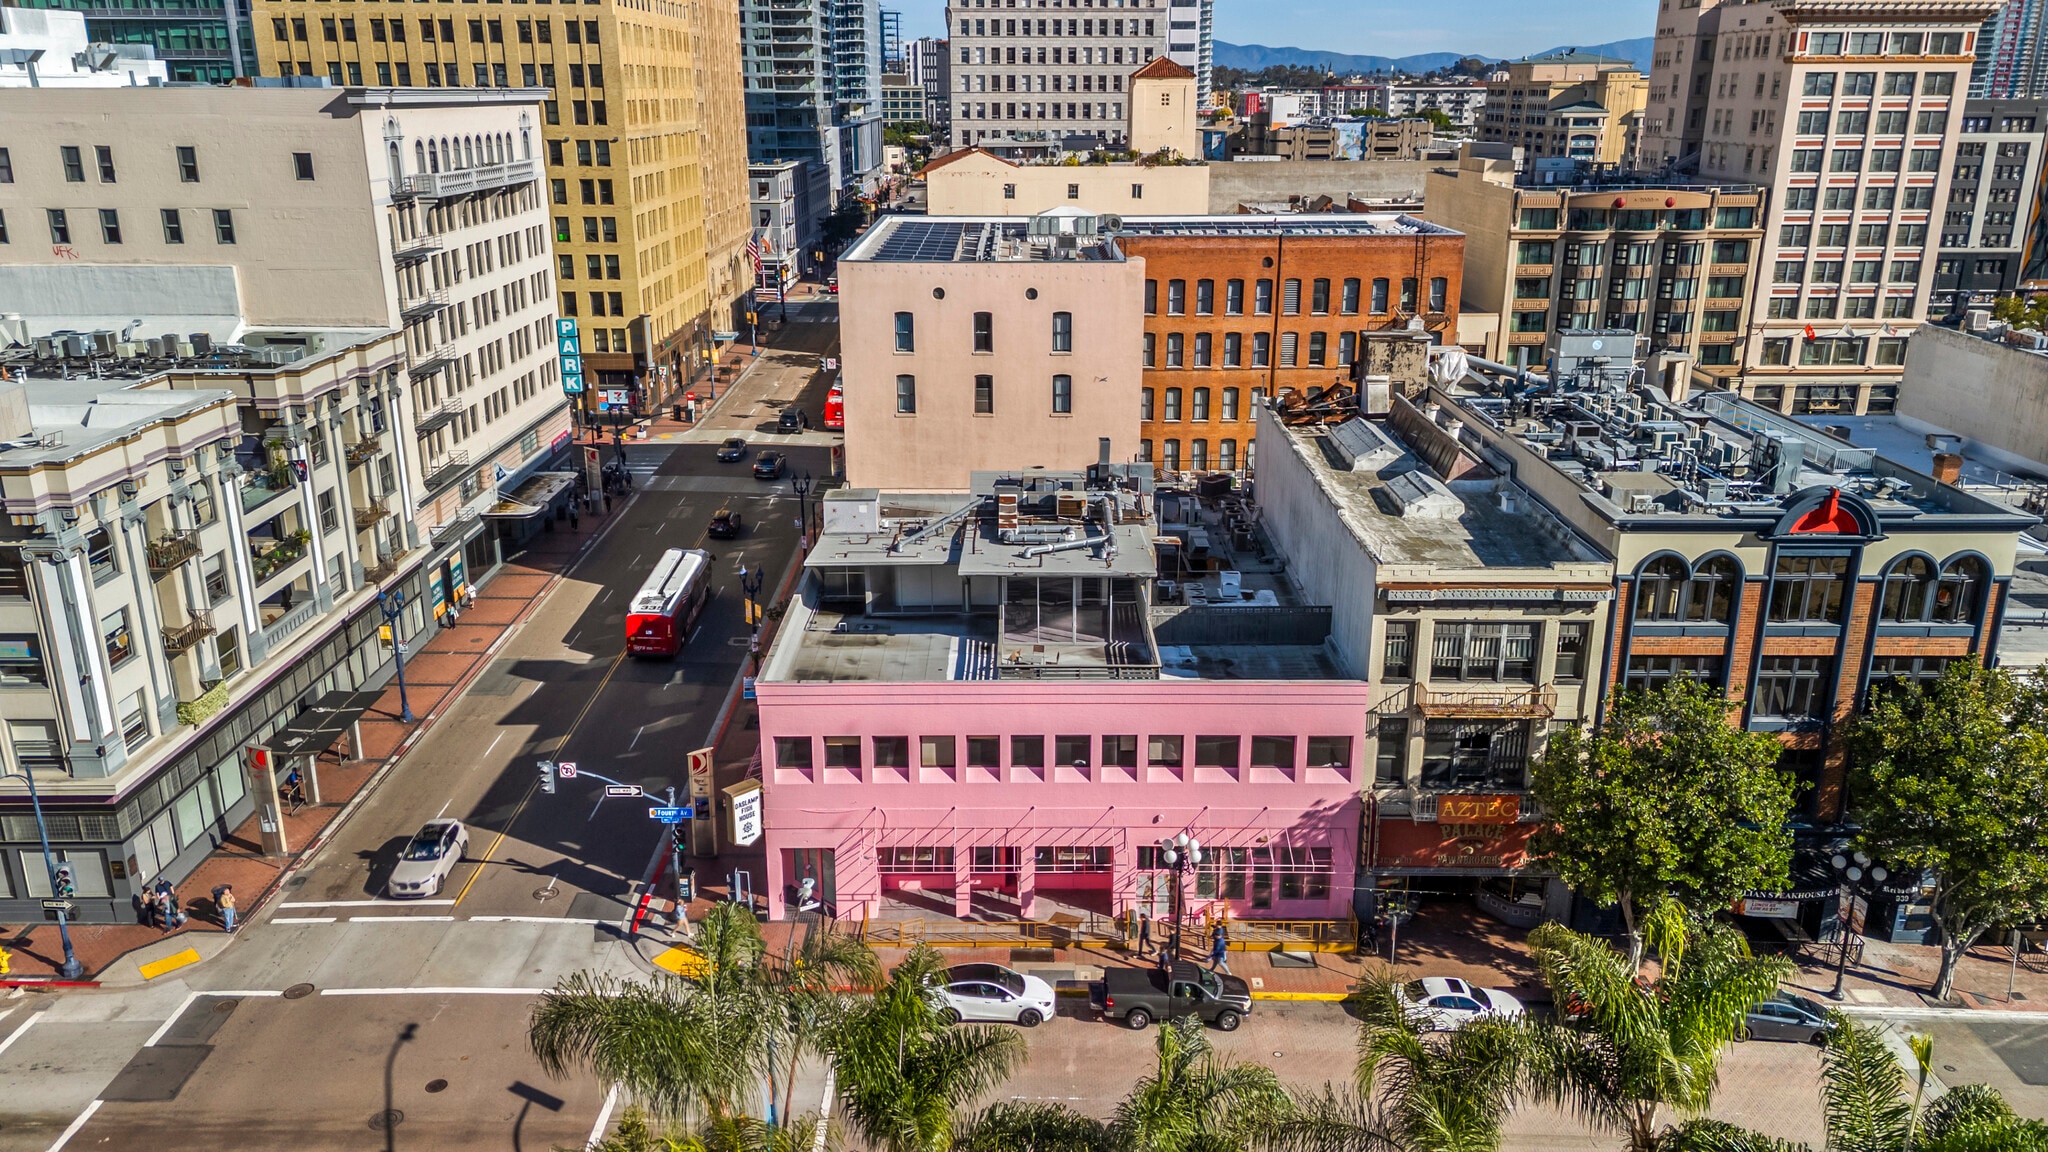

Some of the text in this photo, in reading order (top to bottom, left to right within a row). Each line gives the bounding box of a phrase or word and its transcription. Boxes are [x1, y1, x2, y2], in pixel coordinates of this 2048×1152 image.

[560, 320, 580, 390] PARK
[741, 804, 753, 814] FISH
[1441, 801, 1516, 818] AZTEC
[738, 810, 756, 822] HOUSE
[1440, 824, 1506, 841] PALACE
[1437, 855, 1503, 865] PAWNBROKERS
[1768, 890, 1827, 899] STEAKHOUSE
